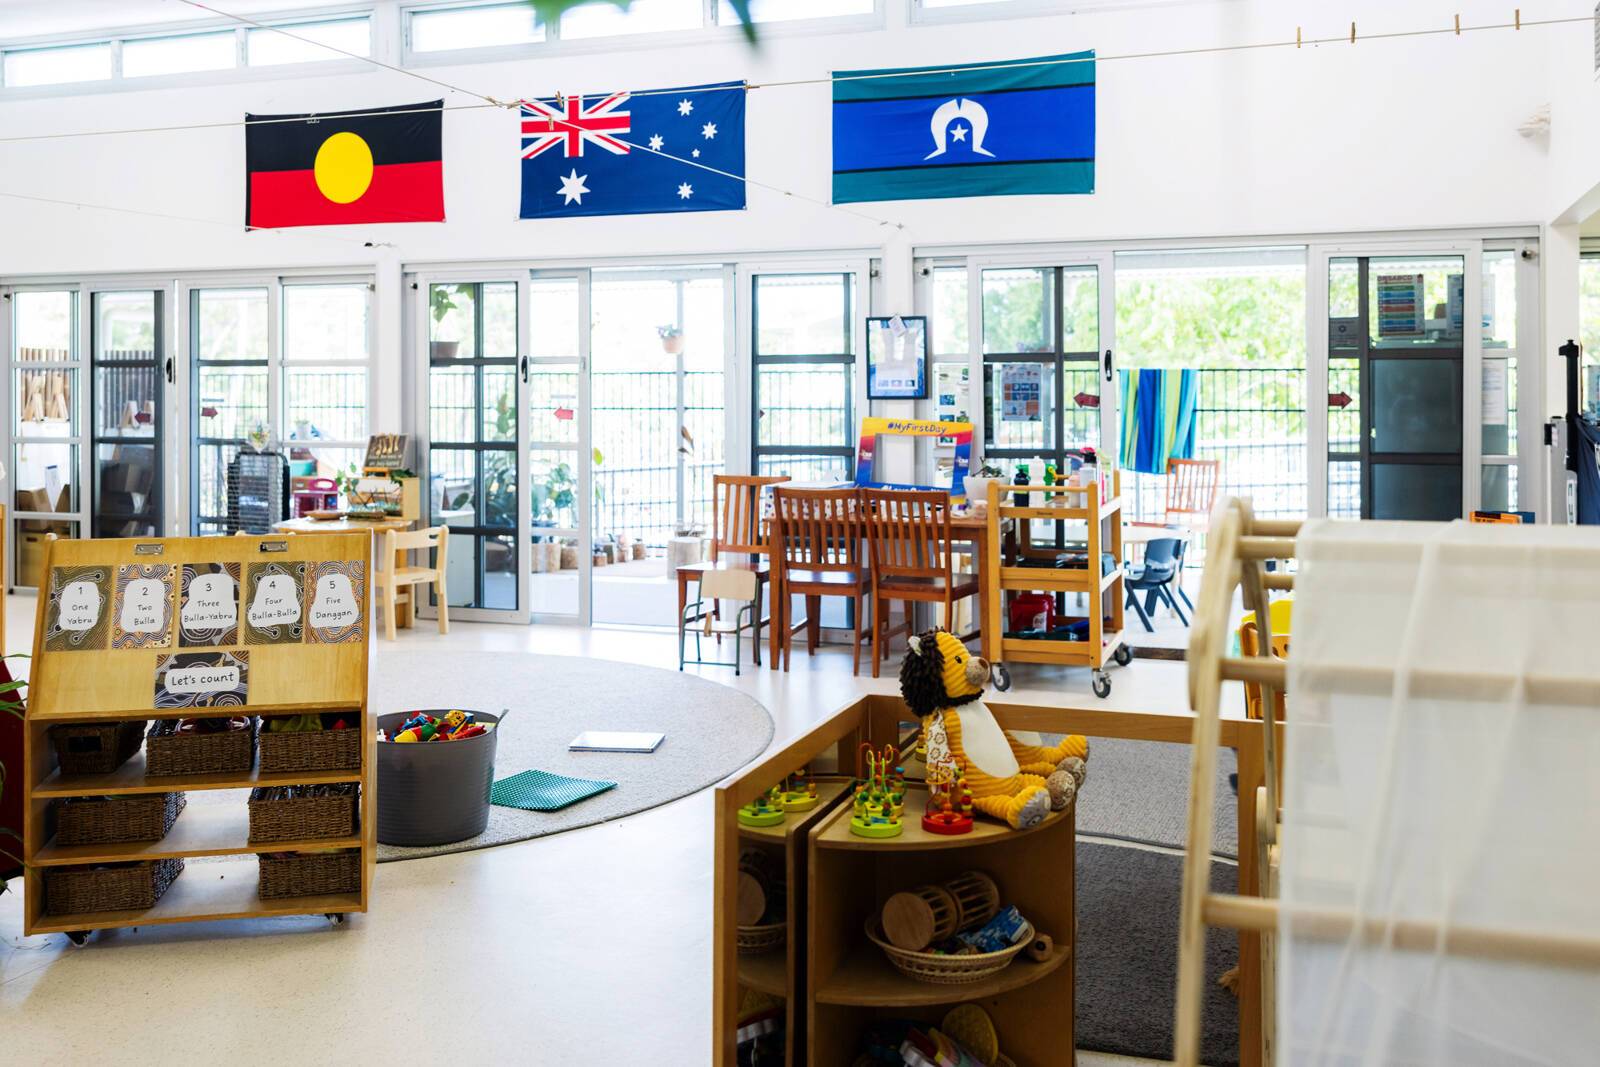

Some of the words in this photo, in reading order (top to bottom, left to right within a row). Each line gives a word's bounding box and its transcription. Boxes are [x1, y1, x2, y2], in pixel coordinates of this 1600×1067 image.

[887, 421, 947, 435] #MyFirstDay
[205, 583, 212, 592] 3
[269, 580, 276, 589] 4
[329, 580, 336, 589] 5
[78, 586, 83, 595] 1
[142, 587, 149, 596] 2
[197, 600, 220, 608] Three
[265, 597, 283, 605] Four
[184, 612, 233, 622] Bulla-Yabru
[252, 609, 297, 621] Bulla-Bulla
[316, 610, 352, 621] Danggan
[66, 617, 92, 625] Yabru
[134, 617, 155, 626] Bulla
[171, 674, 196, 686] Let's
[200, 671, 234, 684] count
